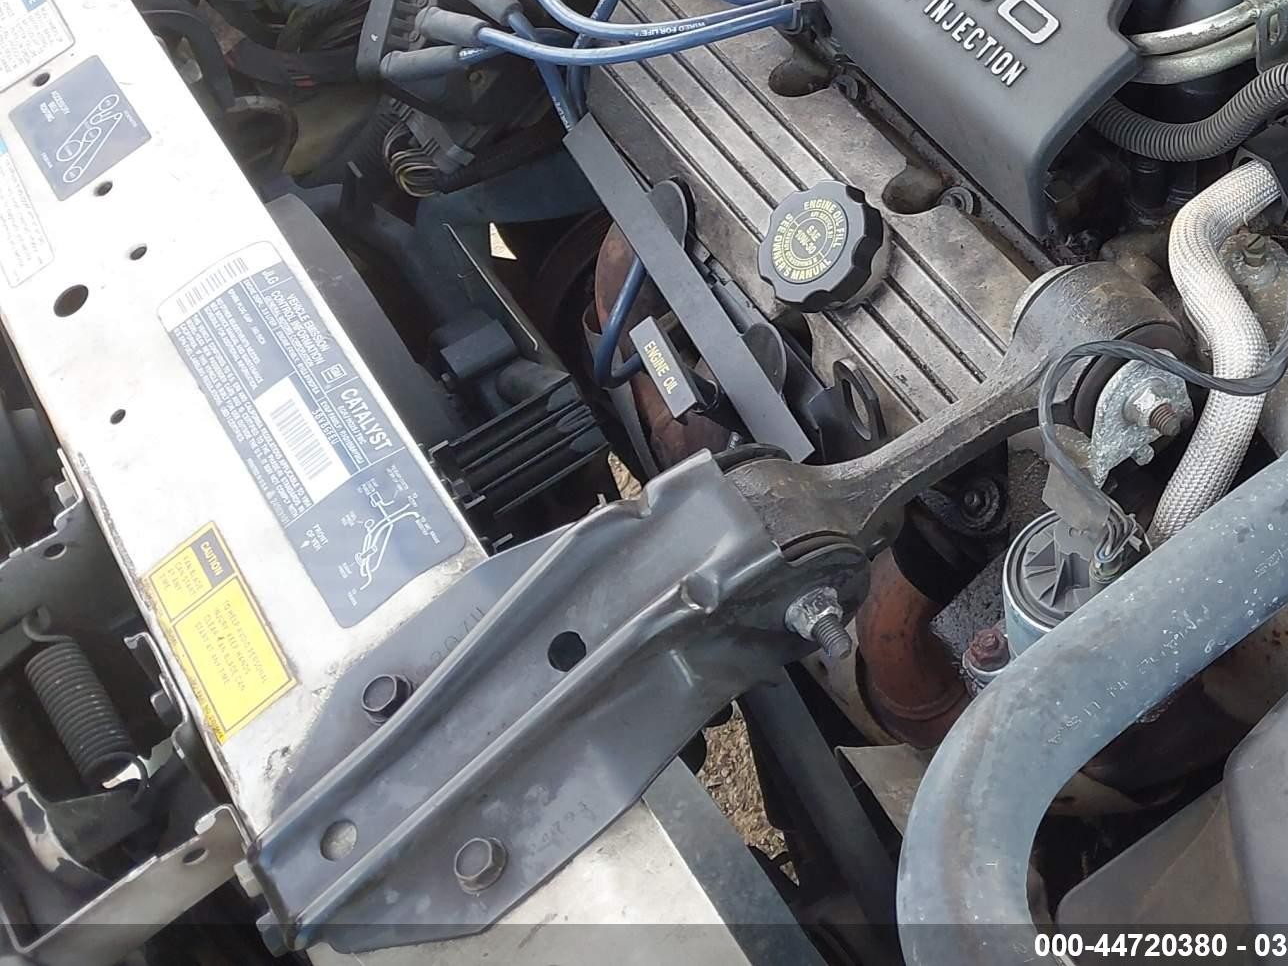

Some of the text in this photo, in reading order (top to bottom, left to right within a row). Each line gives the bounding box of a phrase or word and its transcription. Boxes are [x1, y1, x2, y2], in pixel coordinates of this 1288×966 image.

[659, 25, 677, 34] FOR
[678, 21, 705, 31] WIRED
[777, 212, 793, 233] SEE
[803, 198, 845, 249] ENGINE OIL FILL
[806, 225, 821, 241] SAE
[794, 229, 816, 254] 10W-30
[772, 235, 789, 276] OWNER'S
[790, 258, 831, 279] MANUAL
[269, 289, 297, 322] CONTROL
[289, 319, 326, 365] INFORMATION
[285, 292, 310, 322] VEHICLE
[302, 319, 330, 352] EMISSION
[642, 339, 680, 394] ENGINE OIL
[338, 385, 393, 453] CATALYST
[304, 528, 315, 540] OF
[311, 523, 329, 545] FRONT
[200, 541, 223, 575] CAUTION
